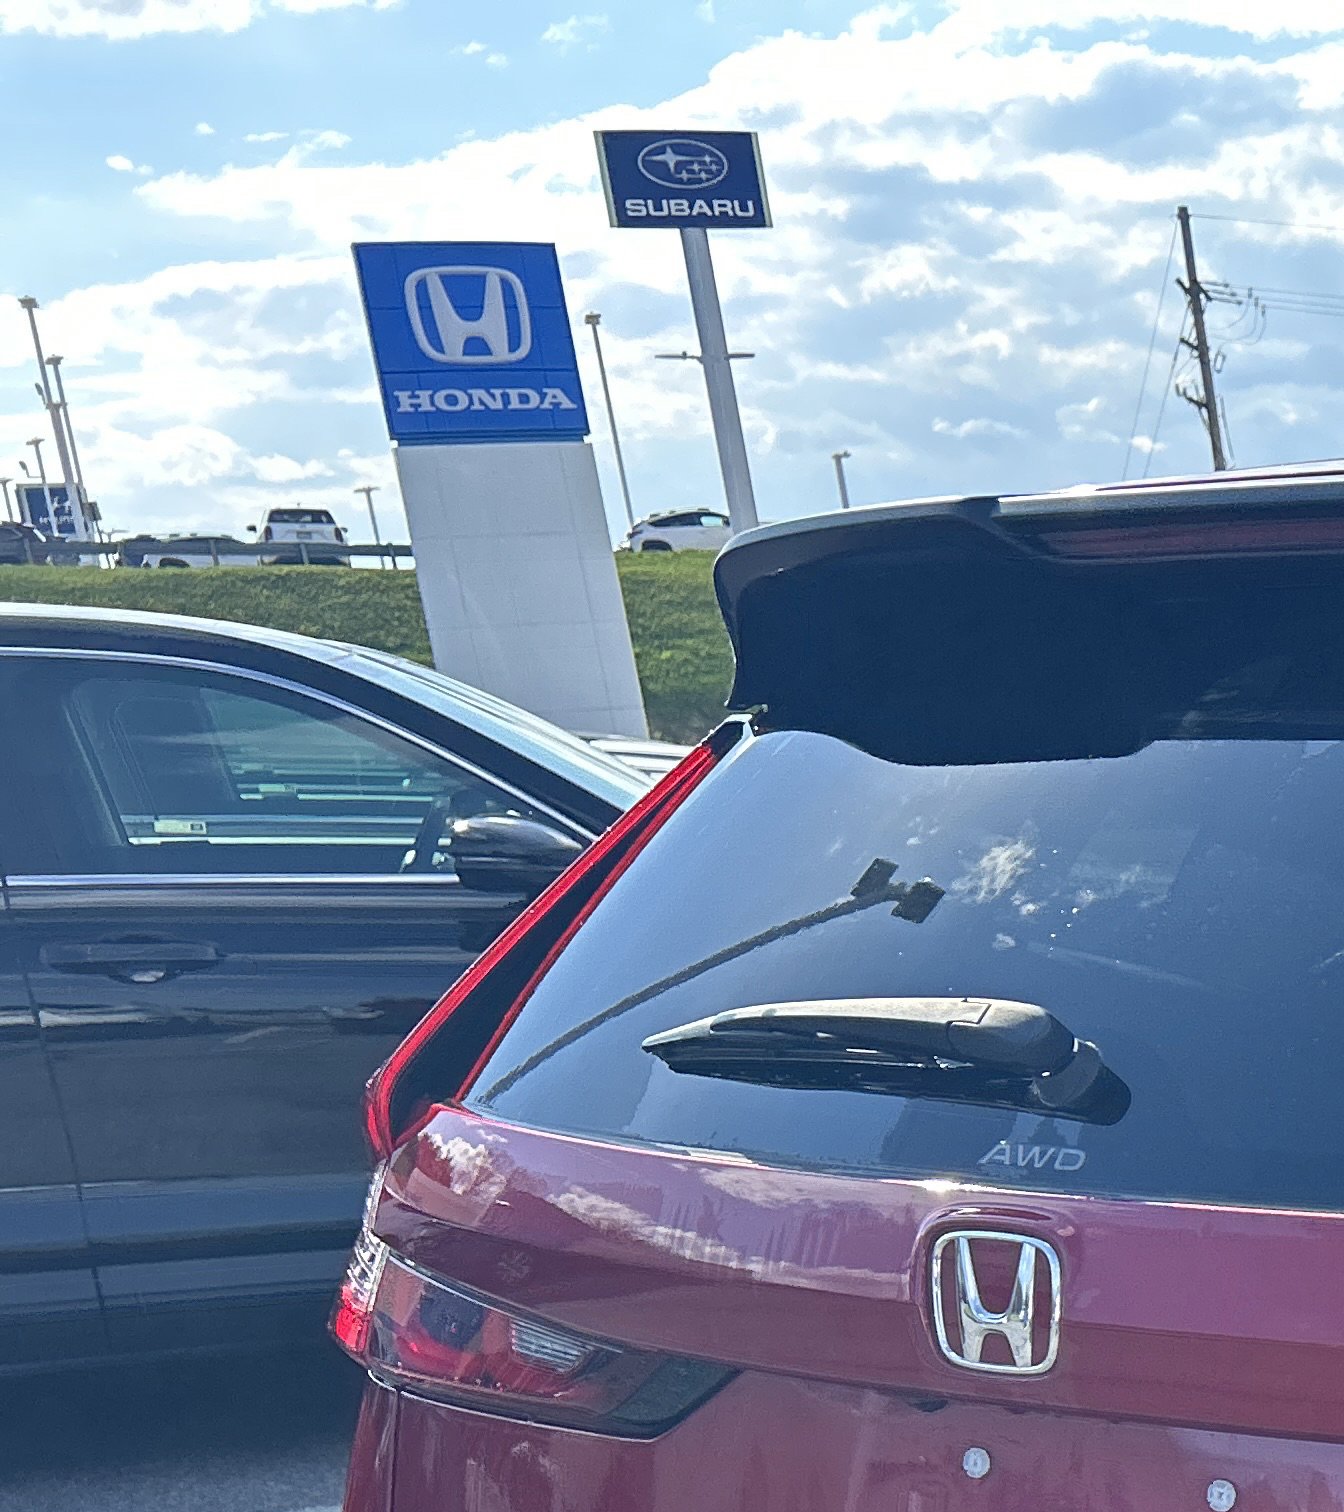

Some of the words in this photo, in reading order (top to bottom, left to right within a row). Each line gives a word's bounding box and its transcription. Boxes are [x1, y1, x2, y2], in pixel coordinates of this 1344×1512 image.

[625, 199, 755, 217] SUBARU
[393, 388, 577, 412] HONDA
[976, 1143, 1087, 1171] AWD
